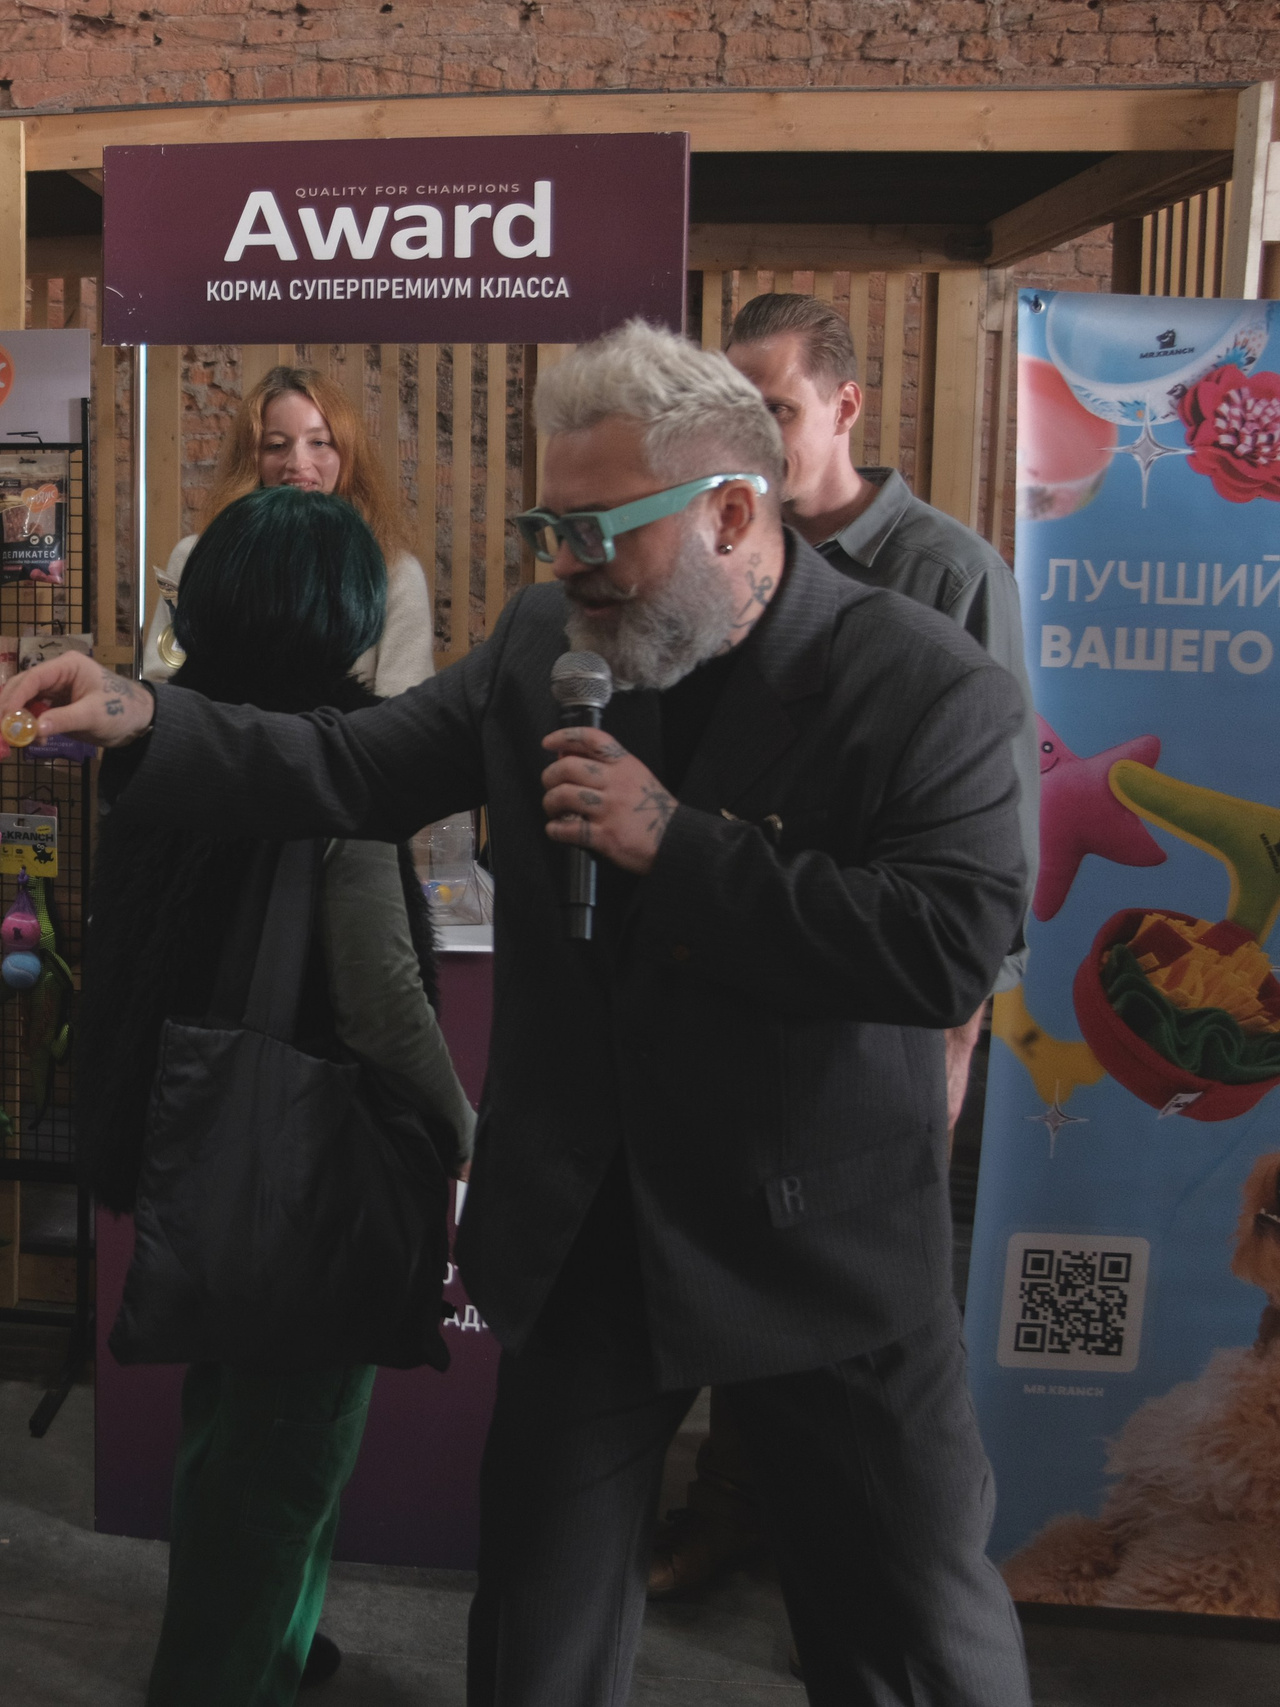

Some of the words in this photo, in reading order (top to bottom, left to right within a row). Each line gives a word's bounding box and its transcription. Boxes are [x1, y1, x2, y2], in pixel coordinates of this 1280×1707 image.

[295, 186, 369, 198] QUALITY
[375, 185, 409, 195] FOR
[416, 183, 521, 195] CHAMPIONS
[223, 180, 552, 262] Award
[206, 280, 282, 302] КОРМА
[288, 278, 473, 300] СУПЕРПРЕМИУМ
[480, 277, 570, 299] КЛАССА
[2, 550, 56, 560] ДЕЛИКАТЕС
[1040, 554, 1280, 607] ЛУЧШИЙ
[1040, 625, 1274, 675] ВАШЕГО
